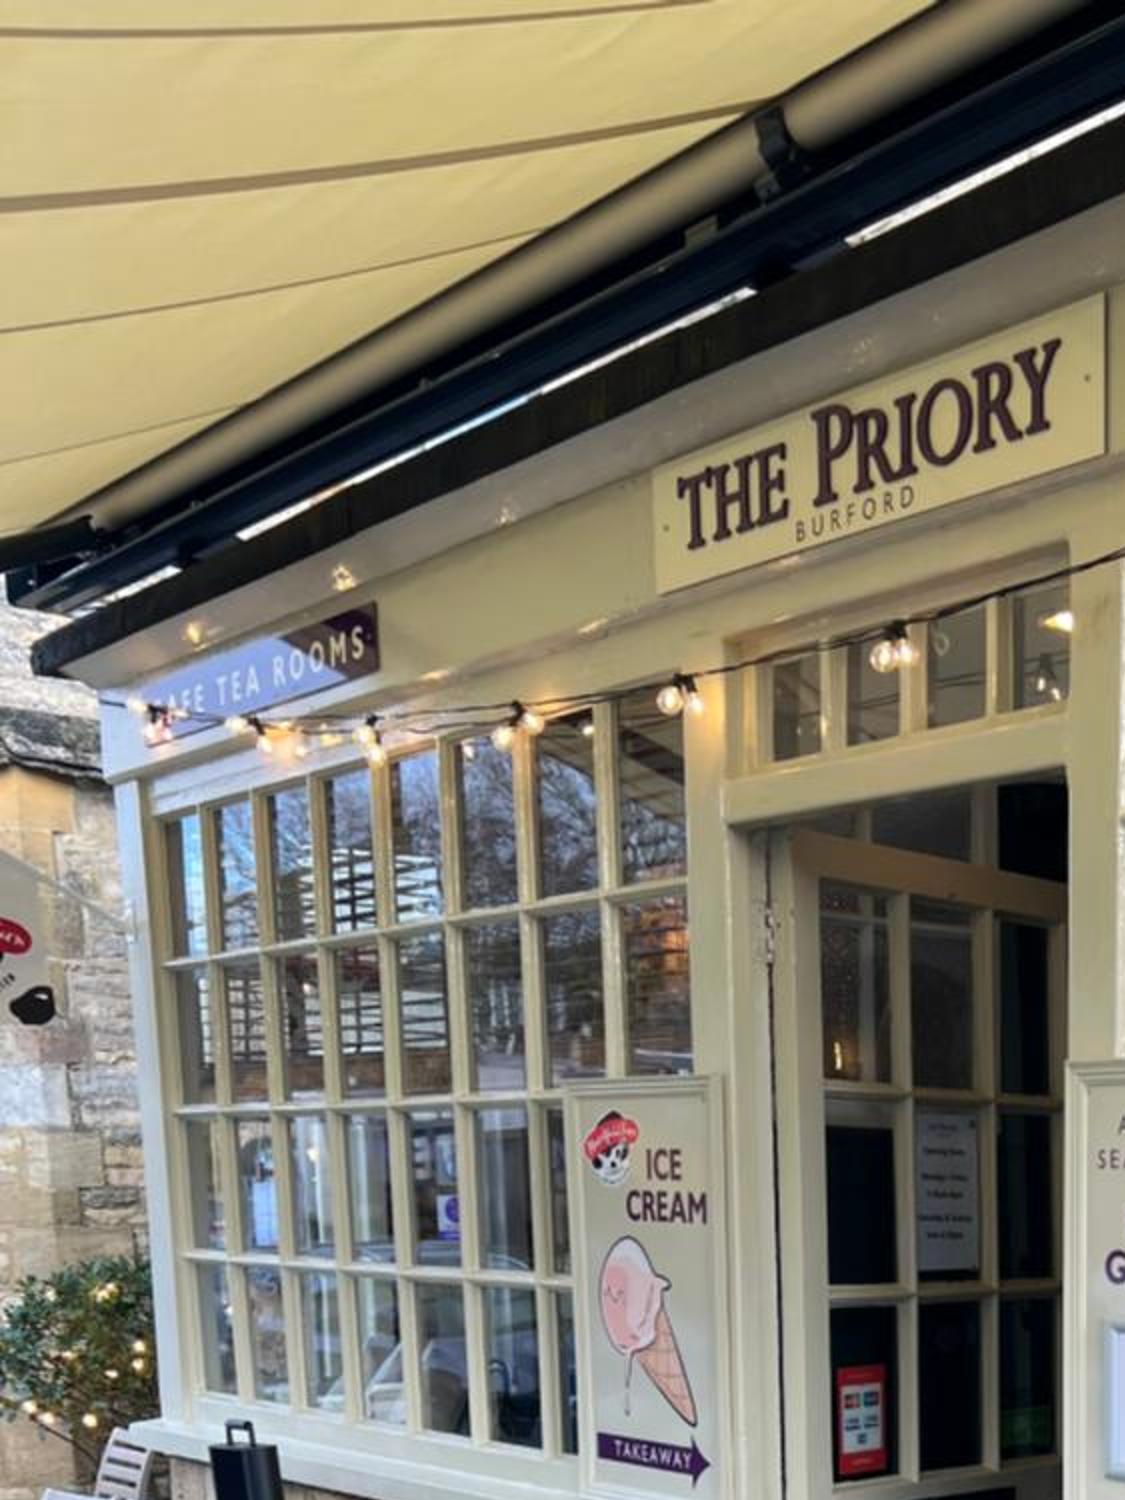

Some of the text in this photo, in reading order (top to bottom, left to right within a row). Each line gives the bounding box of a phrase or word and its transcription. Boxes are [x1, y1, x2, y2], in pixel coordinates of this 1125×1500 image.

[676, 337, 1063, 551] THE PRIORY
[794, 484, 916, 544] BURFORD
[216, 666, 260, 706] TEA
[272, 624, 366, 686] ROOMS
[645, 1148, 682, 1182] ICE
[625, 1188, 708, 1225] CREAM
[612, 1438, 692, 1469] TAKEAWAY
